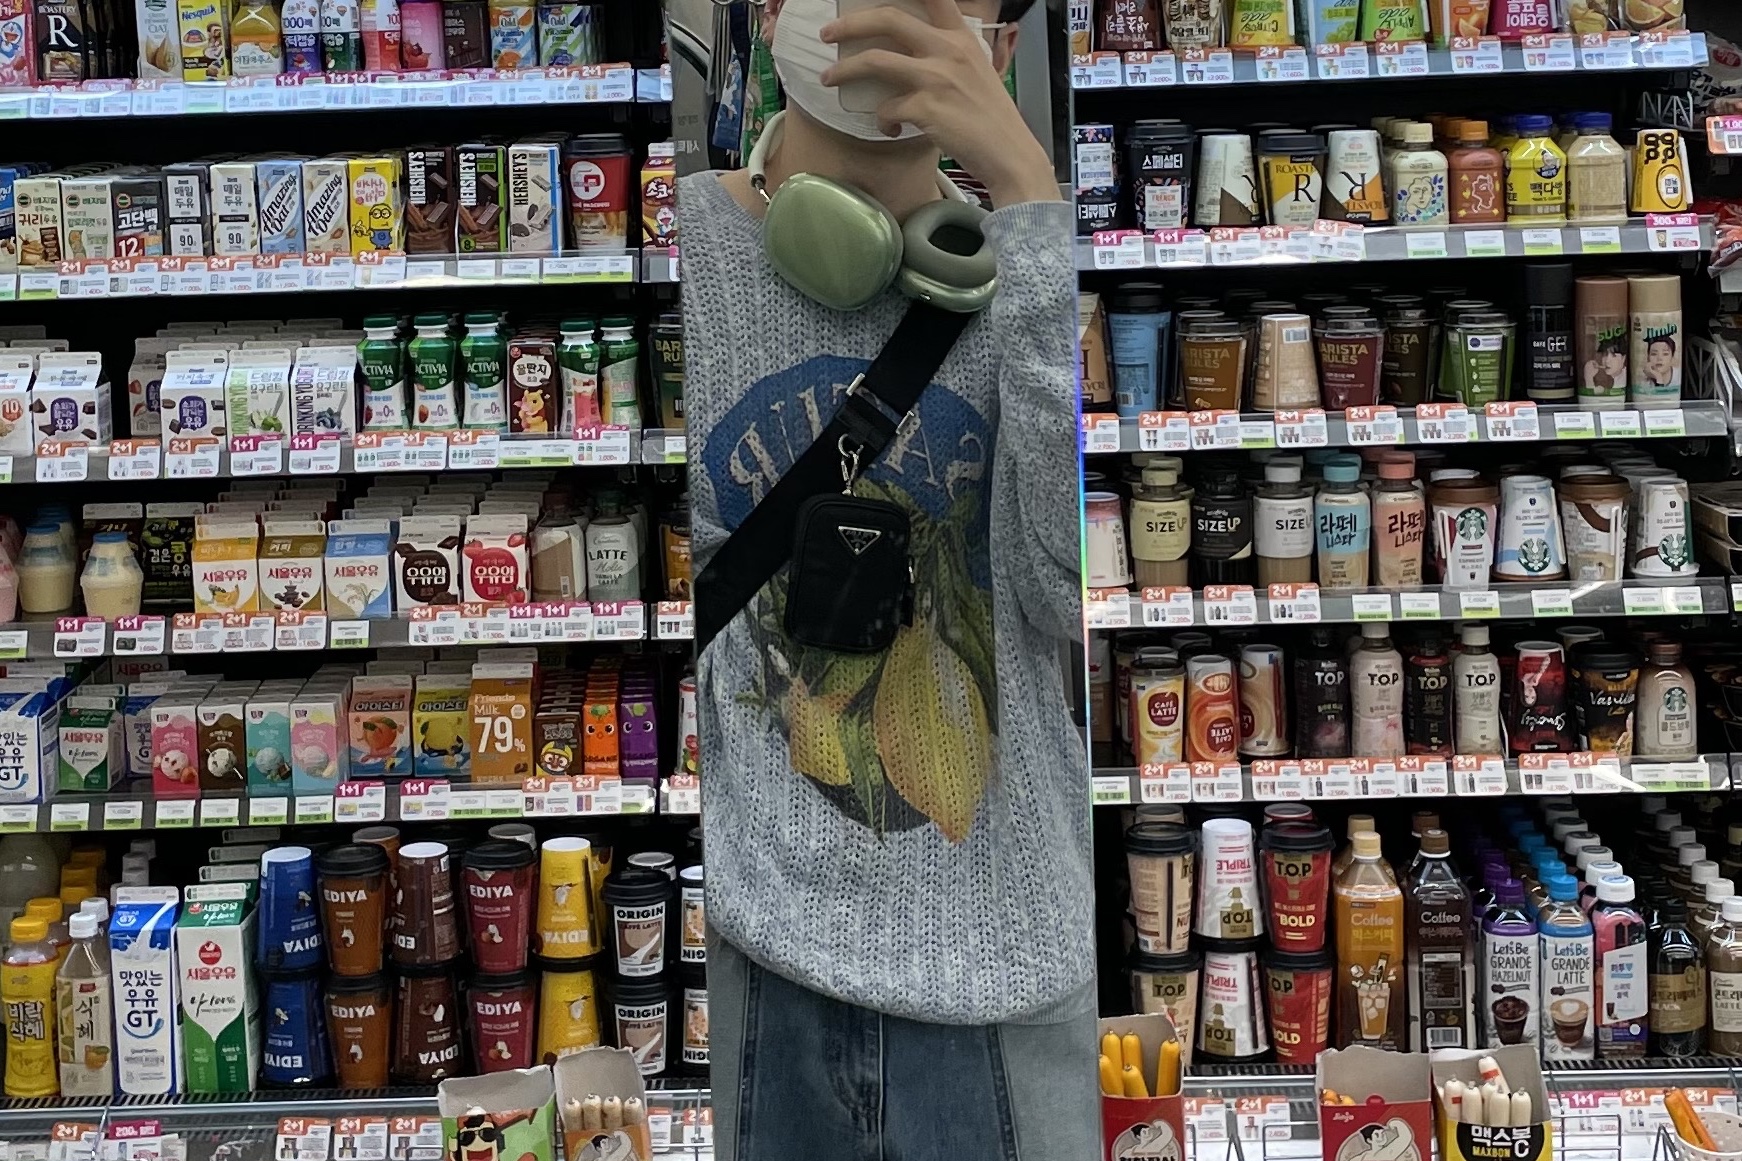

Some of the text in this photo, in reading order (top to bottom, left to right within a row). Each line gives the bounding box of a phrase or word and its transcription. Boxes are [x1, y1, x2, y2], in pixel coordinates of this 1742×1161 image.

[48, 15, 78, 47] R
[1526, 37, 1544, 46] 2+1
[1260, 46, 1278, 56] 2+1
[1379, 42, 1398, 53] 2+1
[1128, 52, 1147, 62] 2+1
[549, 68, 568, 77] 2+1
[277, 74, 299, 85] 1+1
[1142, 154, 1183, 170] 스페셜티
[513, 153, 528, 206] HERSHEY'S
[174, 184, 194, 196] 매일
[223, 184, 242, 195] 매일
[1294, 174, 1316, 202] R
[1340, 171, 1366, 202] R
[175, 197, 194, 209] 두유
[224, 196, 243, 206] 두유
[262, 174, 297, 232] Amazing
[306, 175, 343, 232] Amazing
[118, 209, 159, 230] 고단백
[1097, 233, 1118, 244] 1+1
[1265, 228, 1284, 238] 2+1
[256, 256, 275, 267] 2+1
[360, 252, 378, 262] 2+1
[62, 262, 81, 273] 2+1
[162, 258, 181, 269] 2+1
[1322, 354, 1358, 364] RULES
[1351, 408, 1370, 418] 2+1
[1490, 404, 1509, 414] 2+1
[56, 418, 73, 430] 우유
[184, 416, 203, 429] 우유
[1143, 414, 1161, 424] 2+1
[292, 436, 313, 448] 1+1
[453, 432, 473, 442] 2+1
[113, 441, 132, 453] 2+1
[1146, 521, 1176, 532] SIZE
[1198, 517, 1241, 532] SIZE UP
[1276, 519, 1305, 530] SIZE
[1321, 512, 1357, 534] 라떼
[1326, 533, 1356, 548] 니스타
[589, 550, 627, 562] LATTE
[202, 571, 247, 582] 서울우유
[269, 567, 312, 578] 서울우유
[1208, 588, 1227, 599] 2+1
[464, 604, 483, 614] 2+1
[597, 604, 617, 614] 1+1
[176, 616, 196, 626] 2+1
[280, 613, 299, 623] 2+1
[59, 620, 78, 630] 1+1
[1315, 672, 1344, 686] T.O.P
[1368, 673, 1398, 686] T.O.P
[1418, 676, 1448, 690] T.O.P
[1466, 674, 1496, 687] T.O.P
[356, 701, 403, 711] 아이스티
[420, 701, 467, 711] 아이스티
[475, 704, 499, 715] Milk
[1151, 707, 1177, 716] LATTE
[63, 733, 103, 743] 서울우유
[1401, 758, 1419, 768] 2+1
[1524, 754, 1543, 765] 2+1
[1145, 765, 1163, 775] 2+1
[1304, 761, 1322, 771] 2+1
[526, 779, 545, 789] 2+1
[674, 776, 693, 786] 2+1
[338, 785, 360, 796] 1+1
[1216, 859, 1251, 870] TRIPLE
[1275, 861, 1312, 877] T.O.P
[324, 890, 367, 903] EDIYA
[470, 885, 513, 898] EDIYA
[202, 902, 237, 912] 서울우유
[617, 906, 664, 920] ORIGIN
[1421, 912, 1461, 924] Coffee
[1279, 914, 1316, 927] BOLD
[1351, 914, 1394, 926] Coffee
[1492, 941, 1529, 955] Let's Be
[1554, 943, 1589, 956] Let's Be
[1490, 955, 1532, 969] GRANDE
[1551, 957, 1590, 970] GRANDE
[119, 970, 163, 987] 맛있는
[187, 968, 236, 980] 서울우유
[1491, 969, 1531, 982] HAZELNUT
[1557, 971, 1585, 984] LATTE
[1155, 983, 1186, 995] T.O.P
[125, 989, 159, 1008] 우유
[331, 1005, 375, 1019] EDIYA
[477, 1002, 522, 1015] EDIYA
[618, 1005, 665, 1018] ORIGIN
[76, 997, 95, 1040] 식혜
[127, 1010, 159, 1028] GT
[1626, 1091, 1646, 1101] 2+1
[1241, 1099, 1262, 1110] 2+1
[284, 1120, 304, 1132] 2+1
[396, 1119, 416, 1130] 2+1
[1471, 1126, 1532, 1157] 맥스봉
